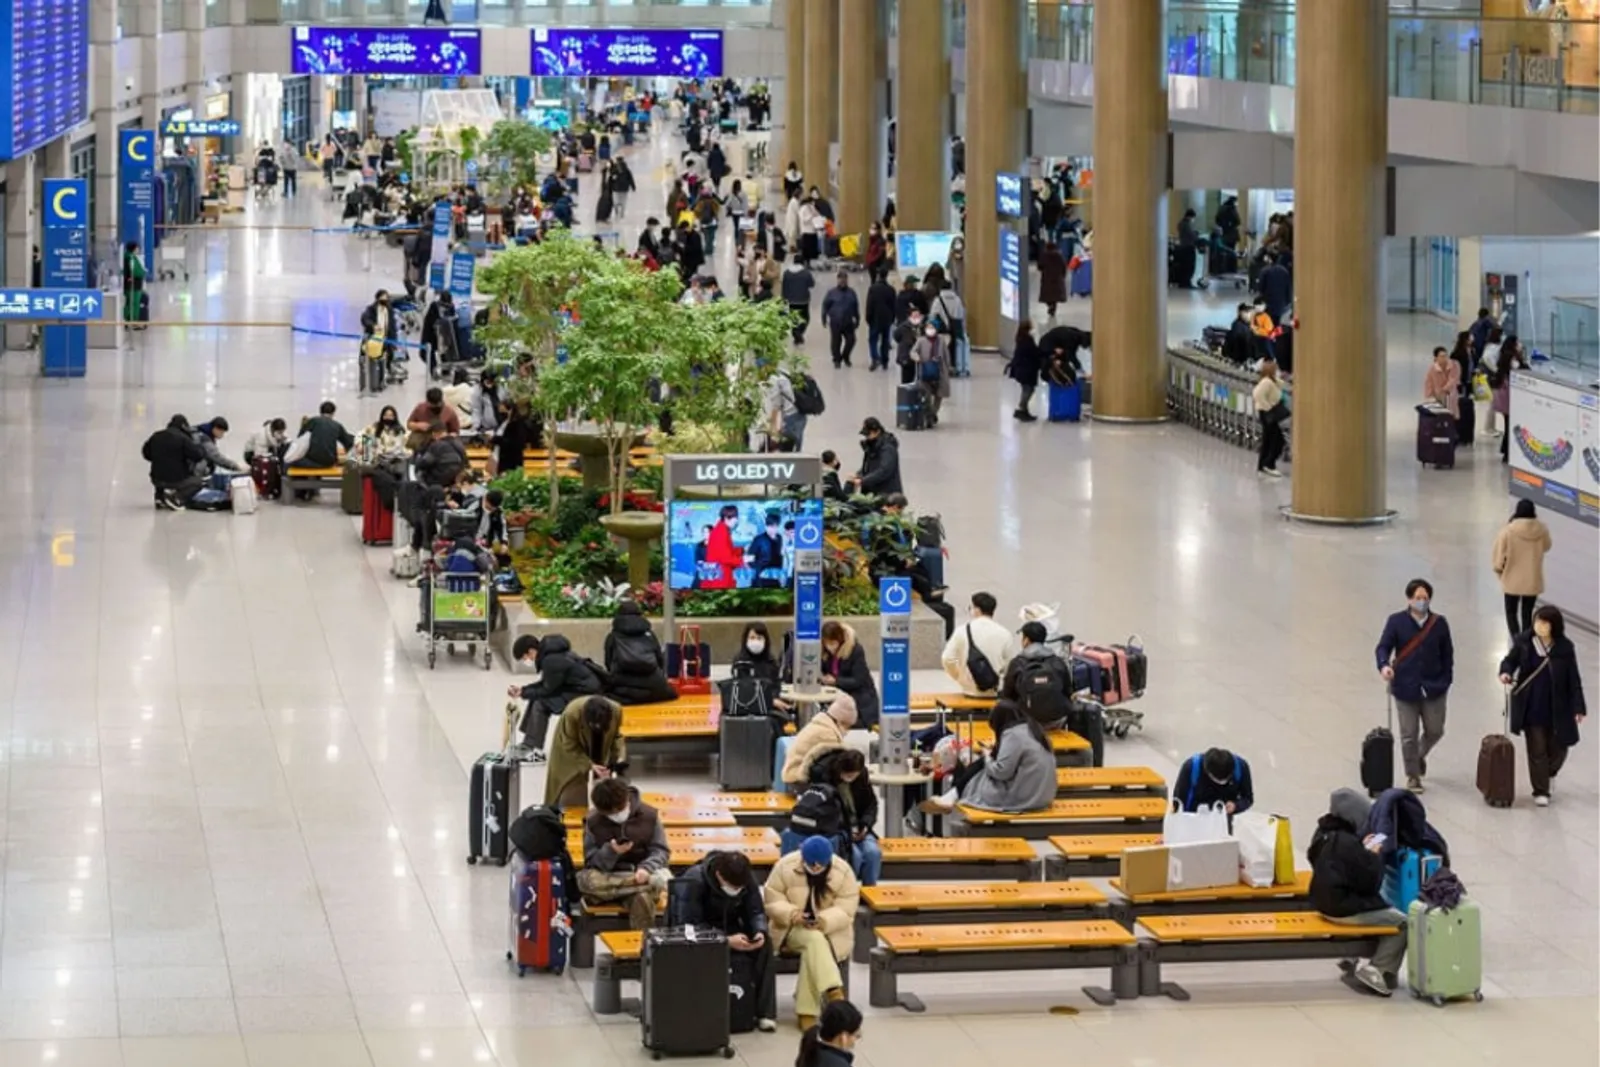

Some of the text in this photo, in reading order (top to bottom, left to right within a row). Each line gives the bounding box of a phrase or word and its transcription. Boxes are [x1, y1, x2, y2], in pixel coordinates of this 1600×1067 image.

[128, 136, 147, 161] C
[53, 187, 78, 220] C
[696, 463, 795, 480] LG OLED TV
